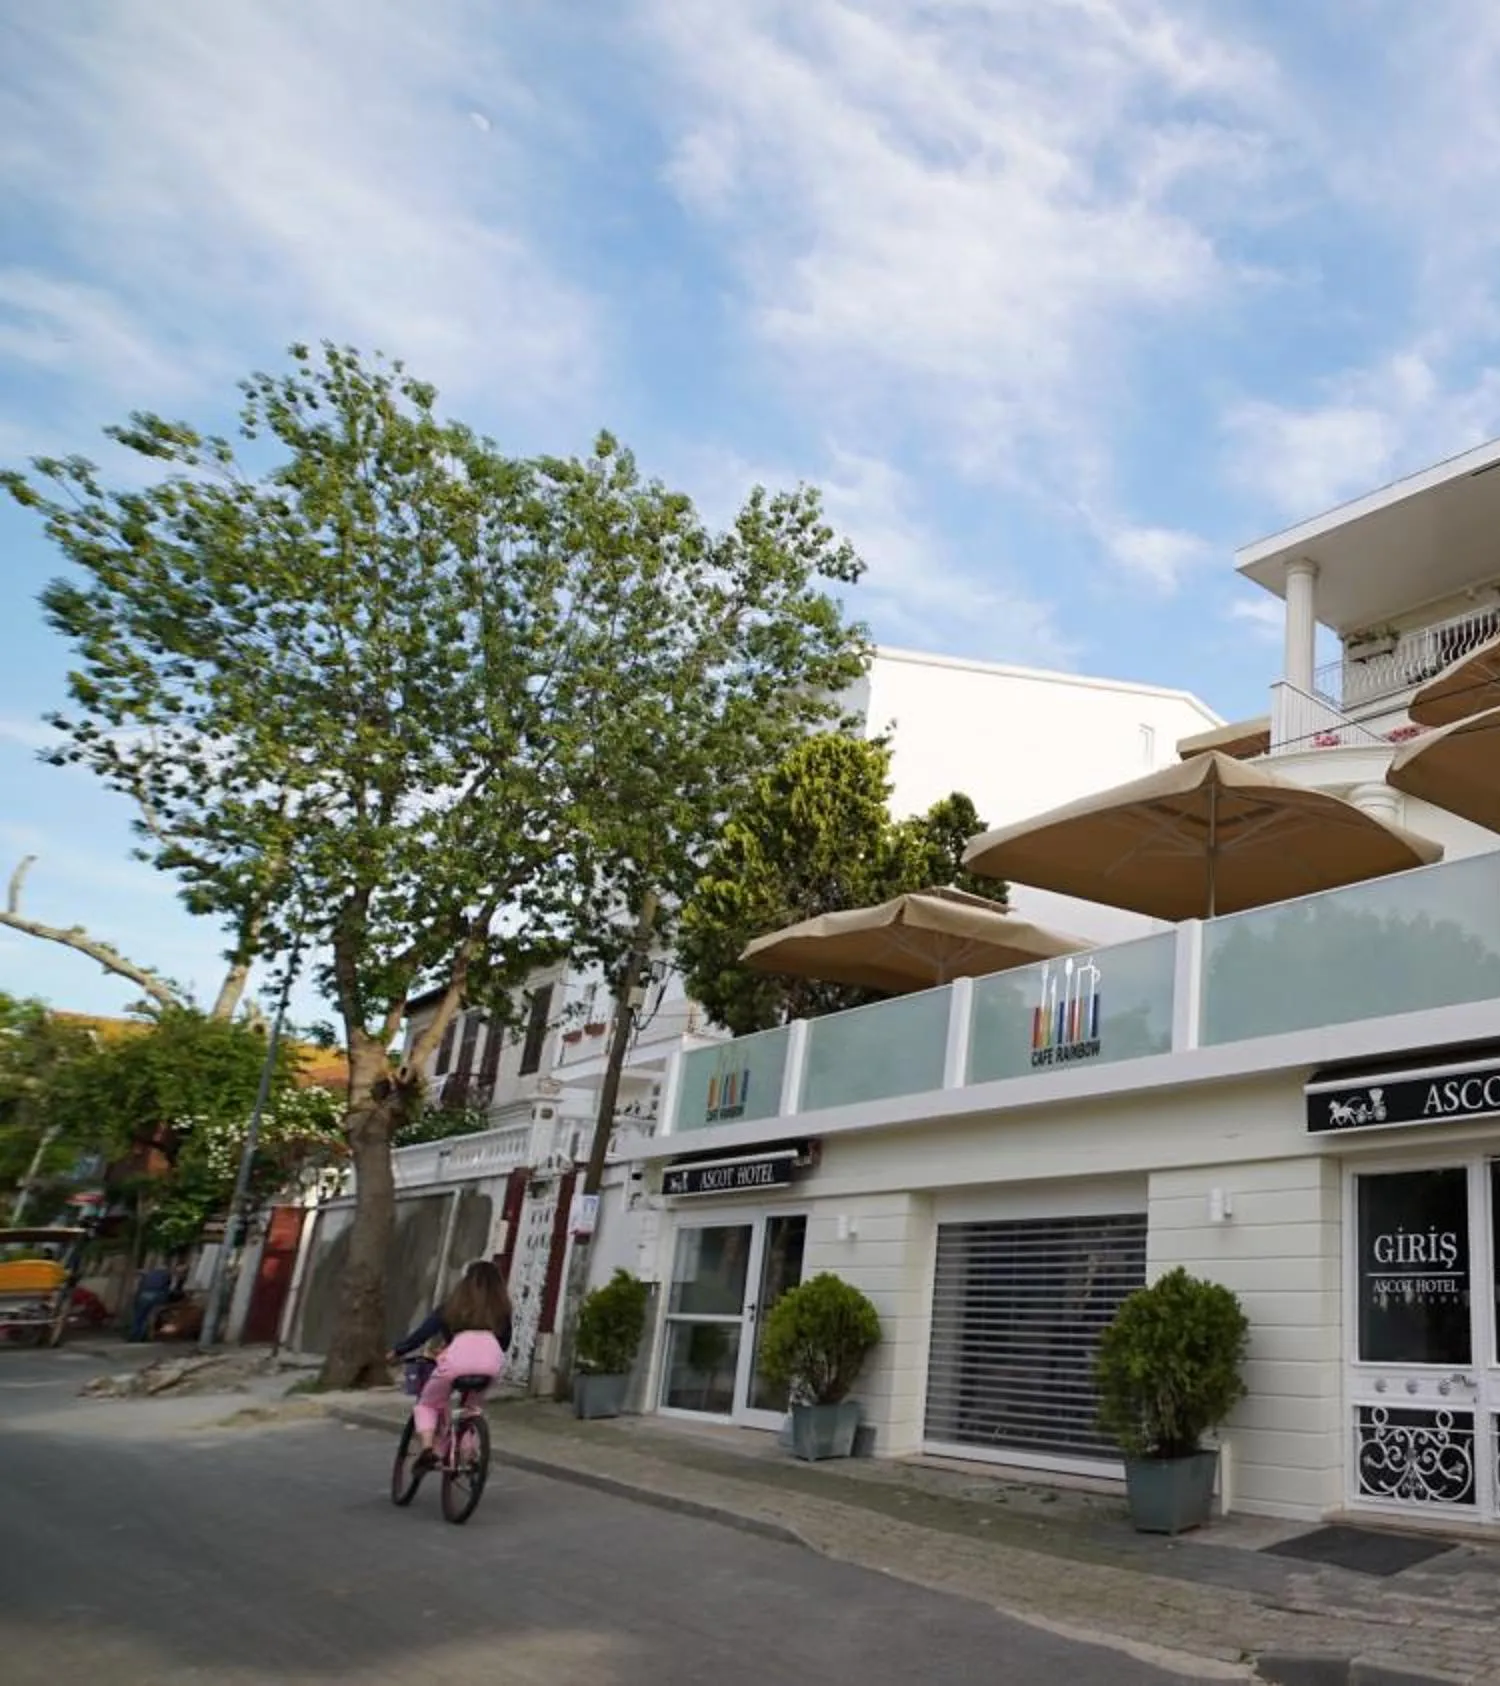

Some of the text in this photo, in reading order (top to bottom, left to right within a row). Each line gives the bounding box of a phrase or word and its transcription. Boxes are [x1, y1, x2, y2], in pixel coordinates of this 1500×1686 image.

[701, 1163, 774, 1189] ASCOT HOTEL
[1373, 1225, 1458, 1269] GİRİŞ
[1373, 1278, 1459, 1294] ASCOT HOTEL
